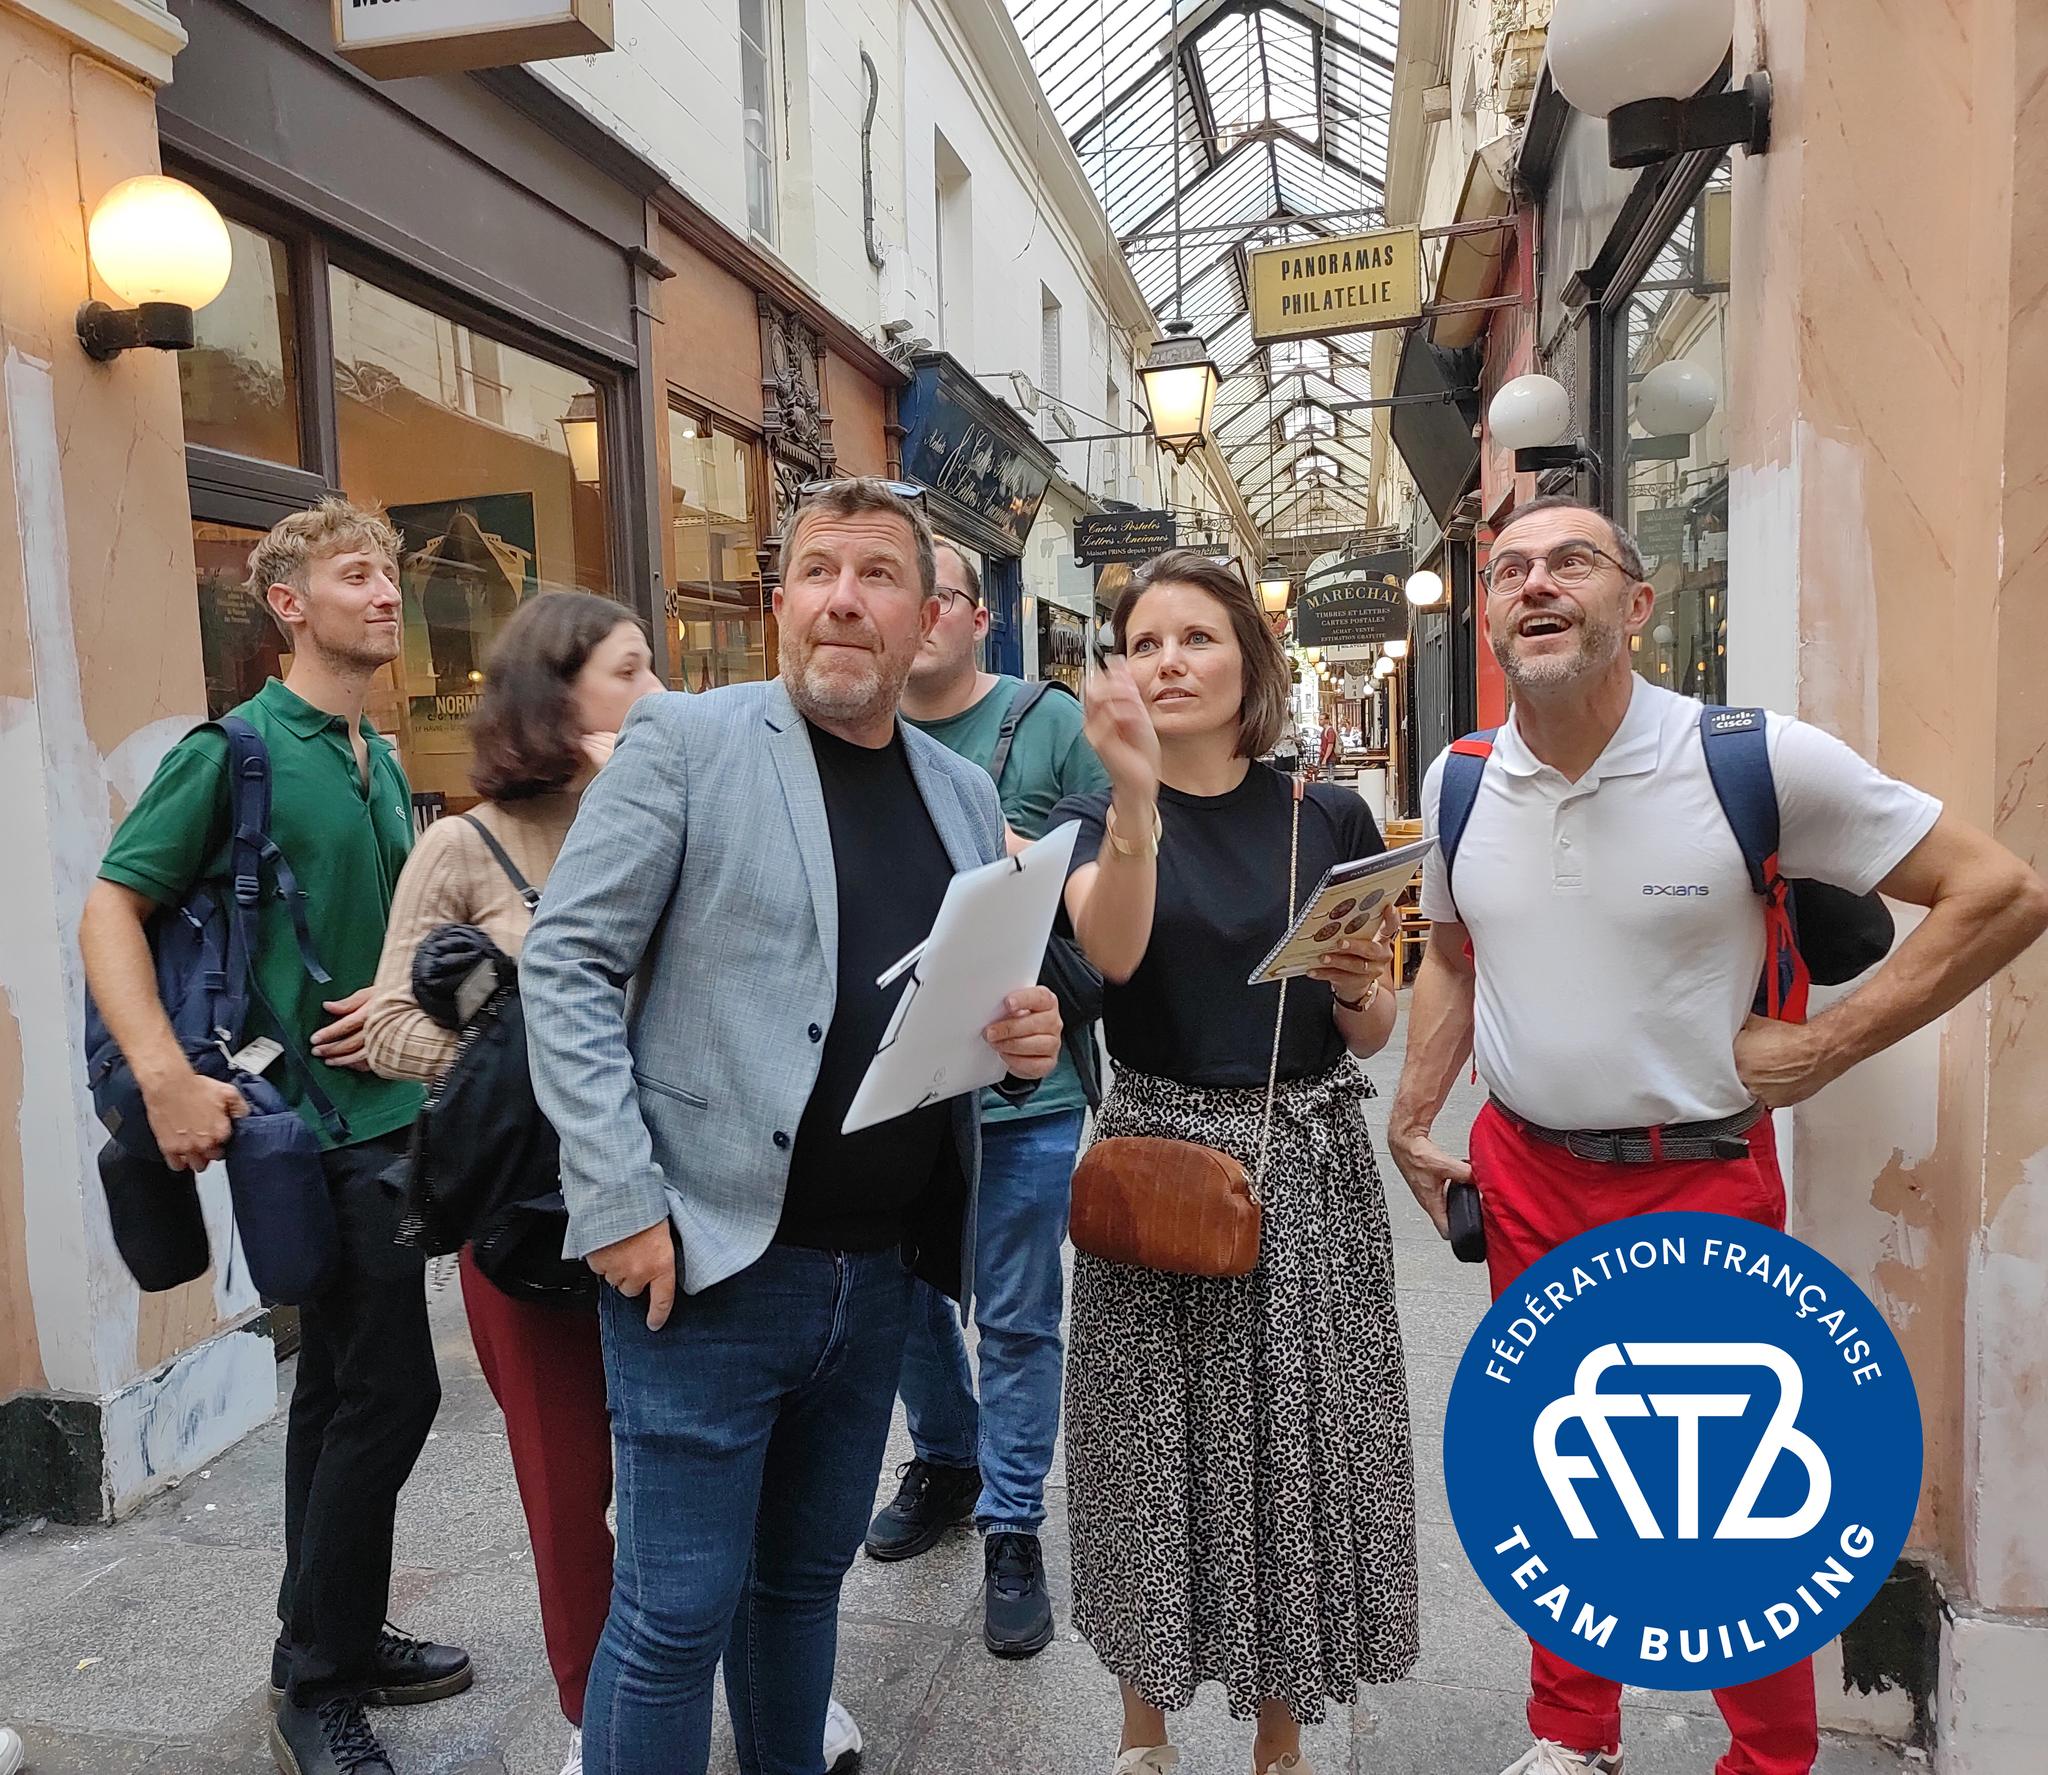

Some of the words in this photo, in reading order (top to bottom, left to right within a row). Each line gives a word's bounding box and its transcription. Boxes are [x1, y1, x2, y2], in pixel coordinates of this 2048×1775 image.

[1281, 245, 1393, 281] PANORAMAS
[1282, 281, 1391, 316] PHILATELIE
[1088, 521, 1117, 534] Cartes
[1120, 518, 1161, 532] Postales
[1080, 534, 1115, 548] Lettres
[1117, 532, 1169, 545] Anciennes
[1306, 584, 1401, 610] MARÉCHAL
[1315, 611, 1347, 619] TIMBRES
[1348, 609, 1358, 617] ET
[1359, 607, 1391, 615] LETTRES
[1321, 618, 1349, 627] CARTES
[1350, 615, 1386, 625] POSTALES
[1320, 634, 1356, 642] ESTIMATION
[1642, 885, 1709, 896] axians
